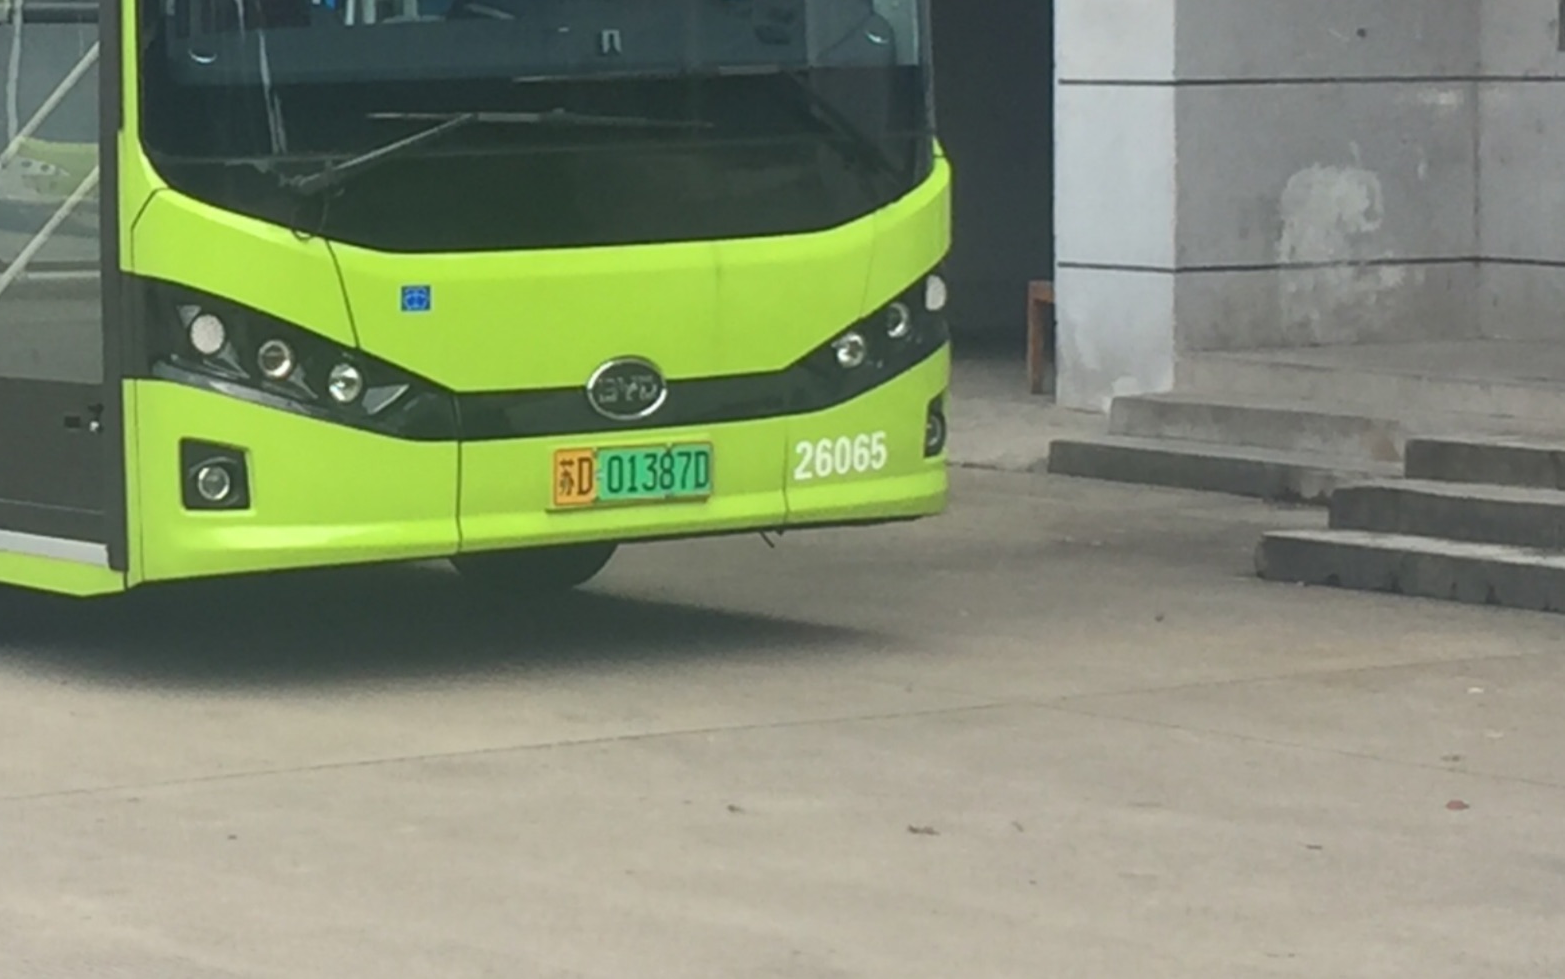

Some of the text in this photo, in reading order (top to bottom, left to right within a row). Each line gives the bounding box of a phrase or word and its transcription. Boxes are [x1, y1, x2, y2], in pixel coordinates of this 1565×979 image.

[559, 450, 710, 496] 苏D 01387D
[794, 431, 888, 481] 26065
